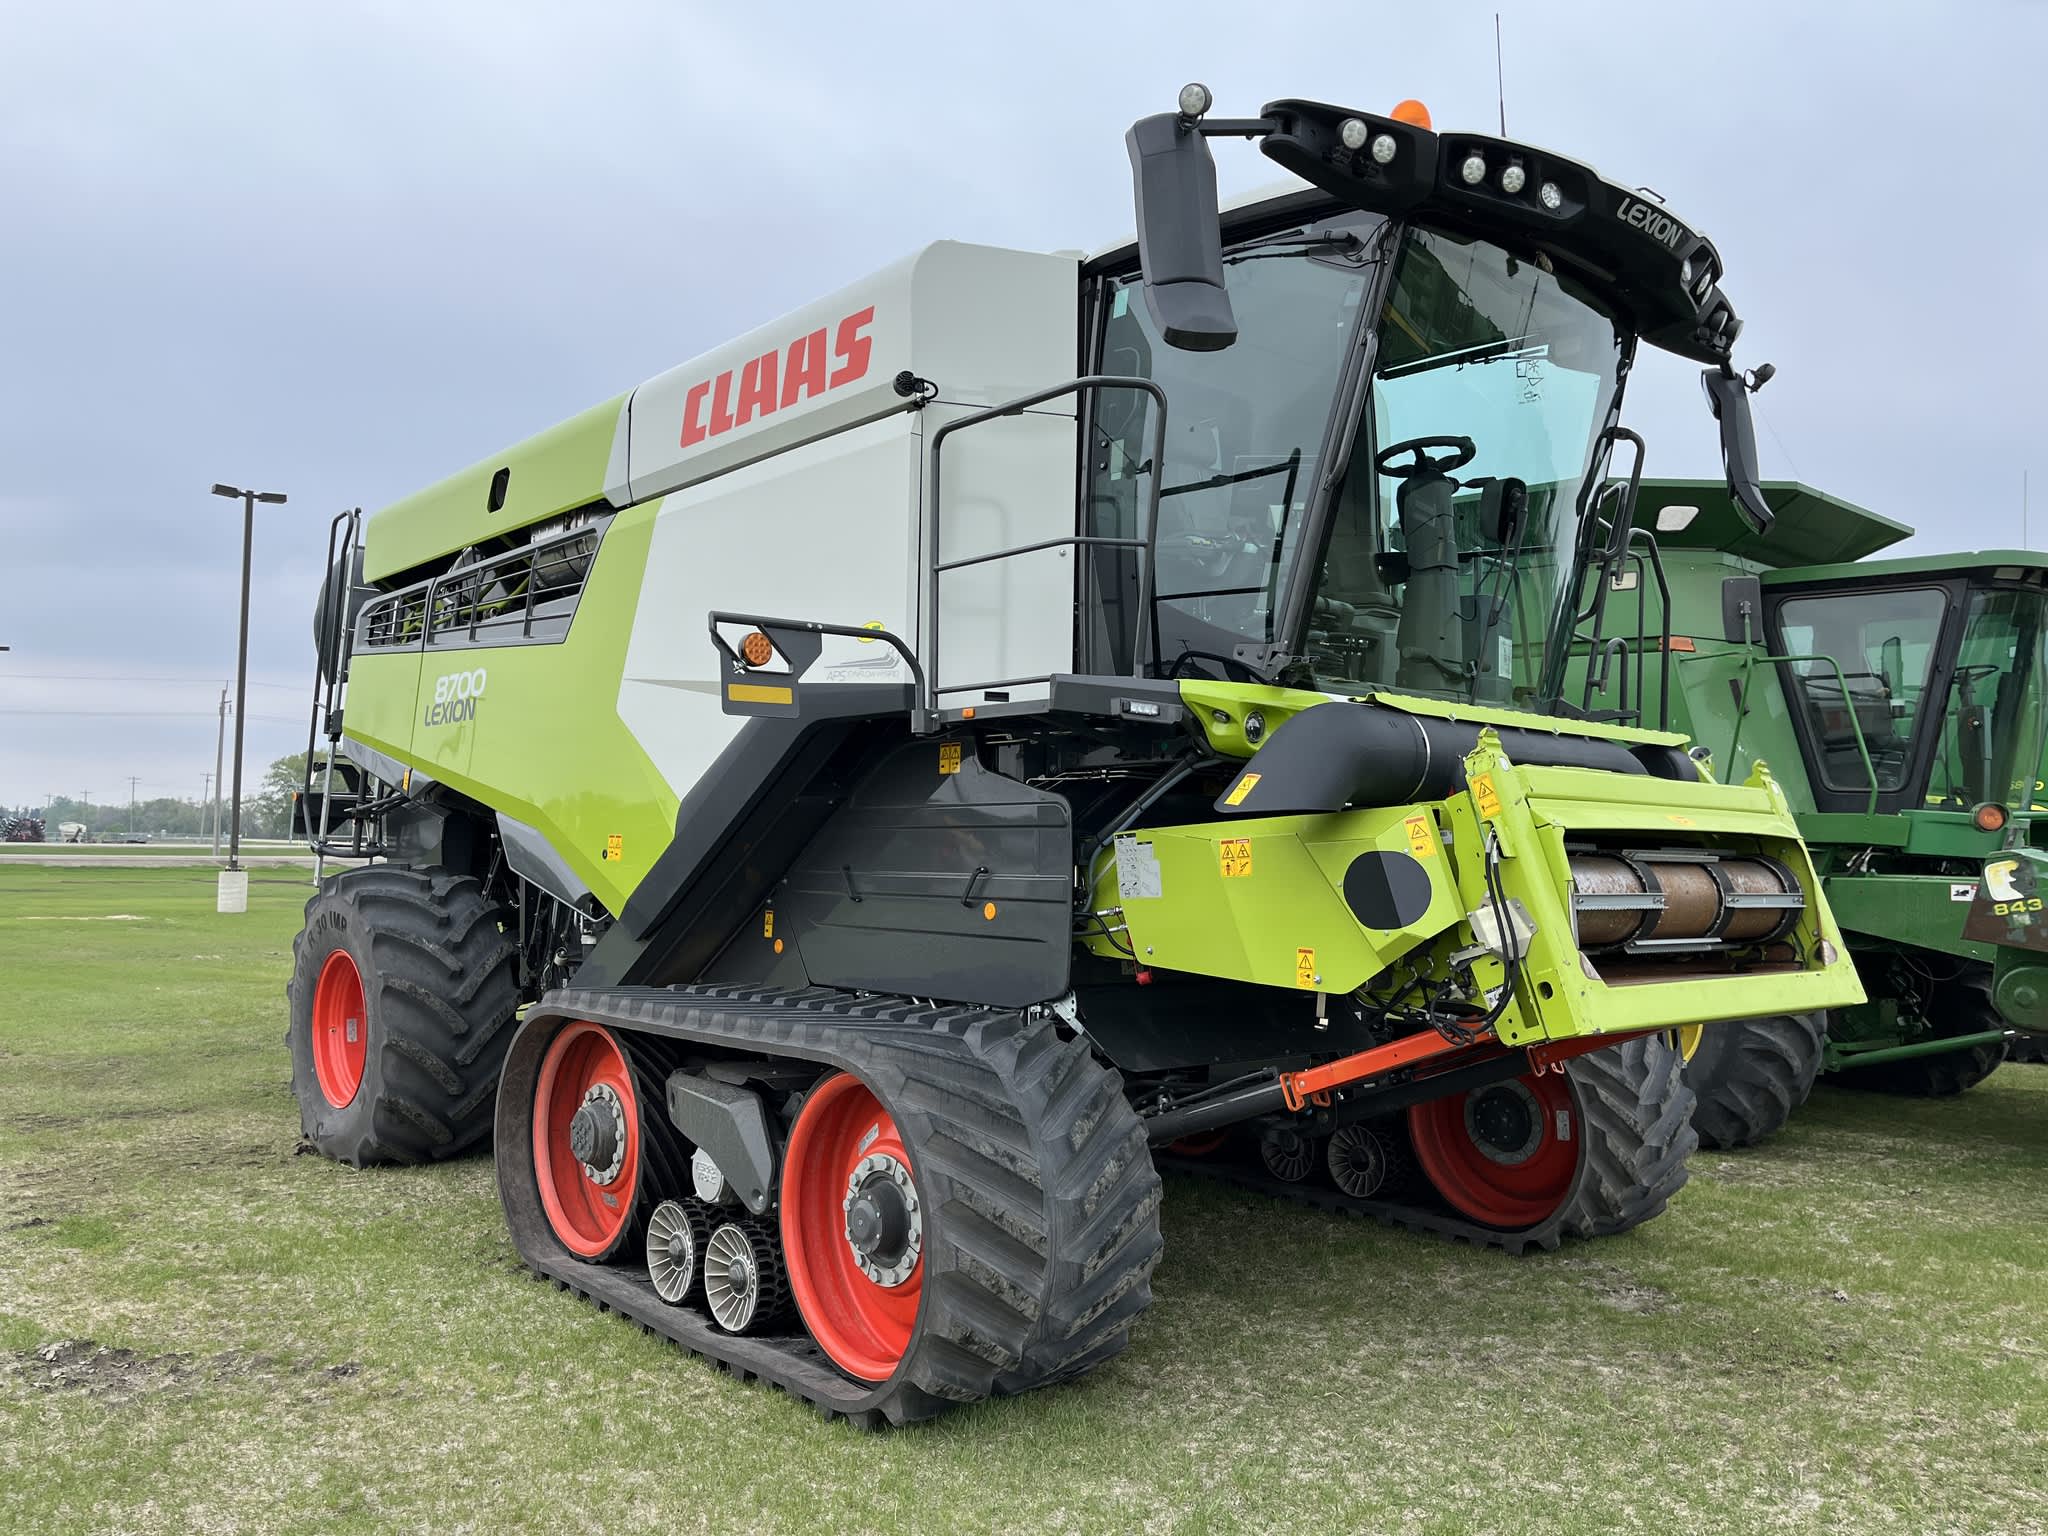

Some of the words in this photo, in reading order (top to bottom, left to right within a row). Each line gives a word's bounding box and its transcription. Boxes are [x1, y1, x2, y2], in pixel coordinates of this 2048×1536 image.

[1616, 197, 1683, 249] LEXION
[680, 305, 875, 448] CLAAS
[434, 667, 487, 704] 8700
[424, 697, 476, 727] LEXION
[1993, 898, 2043, 916] 843
